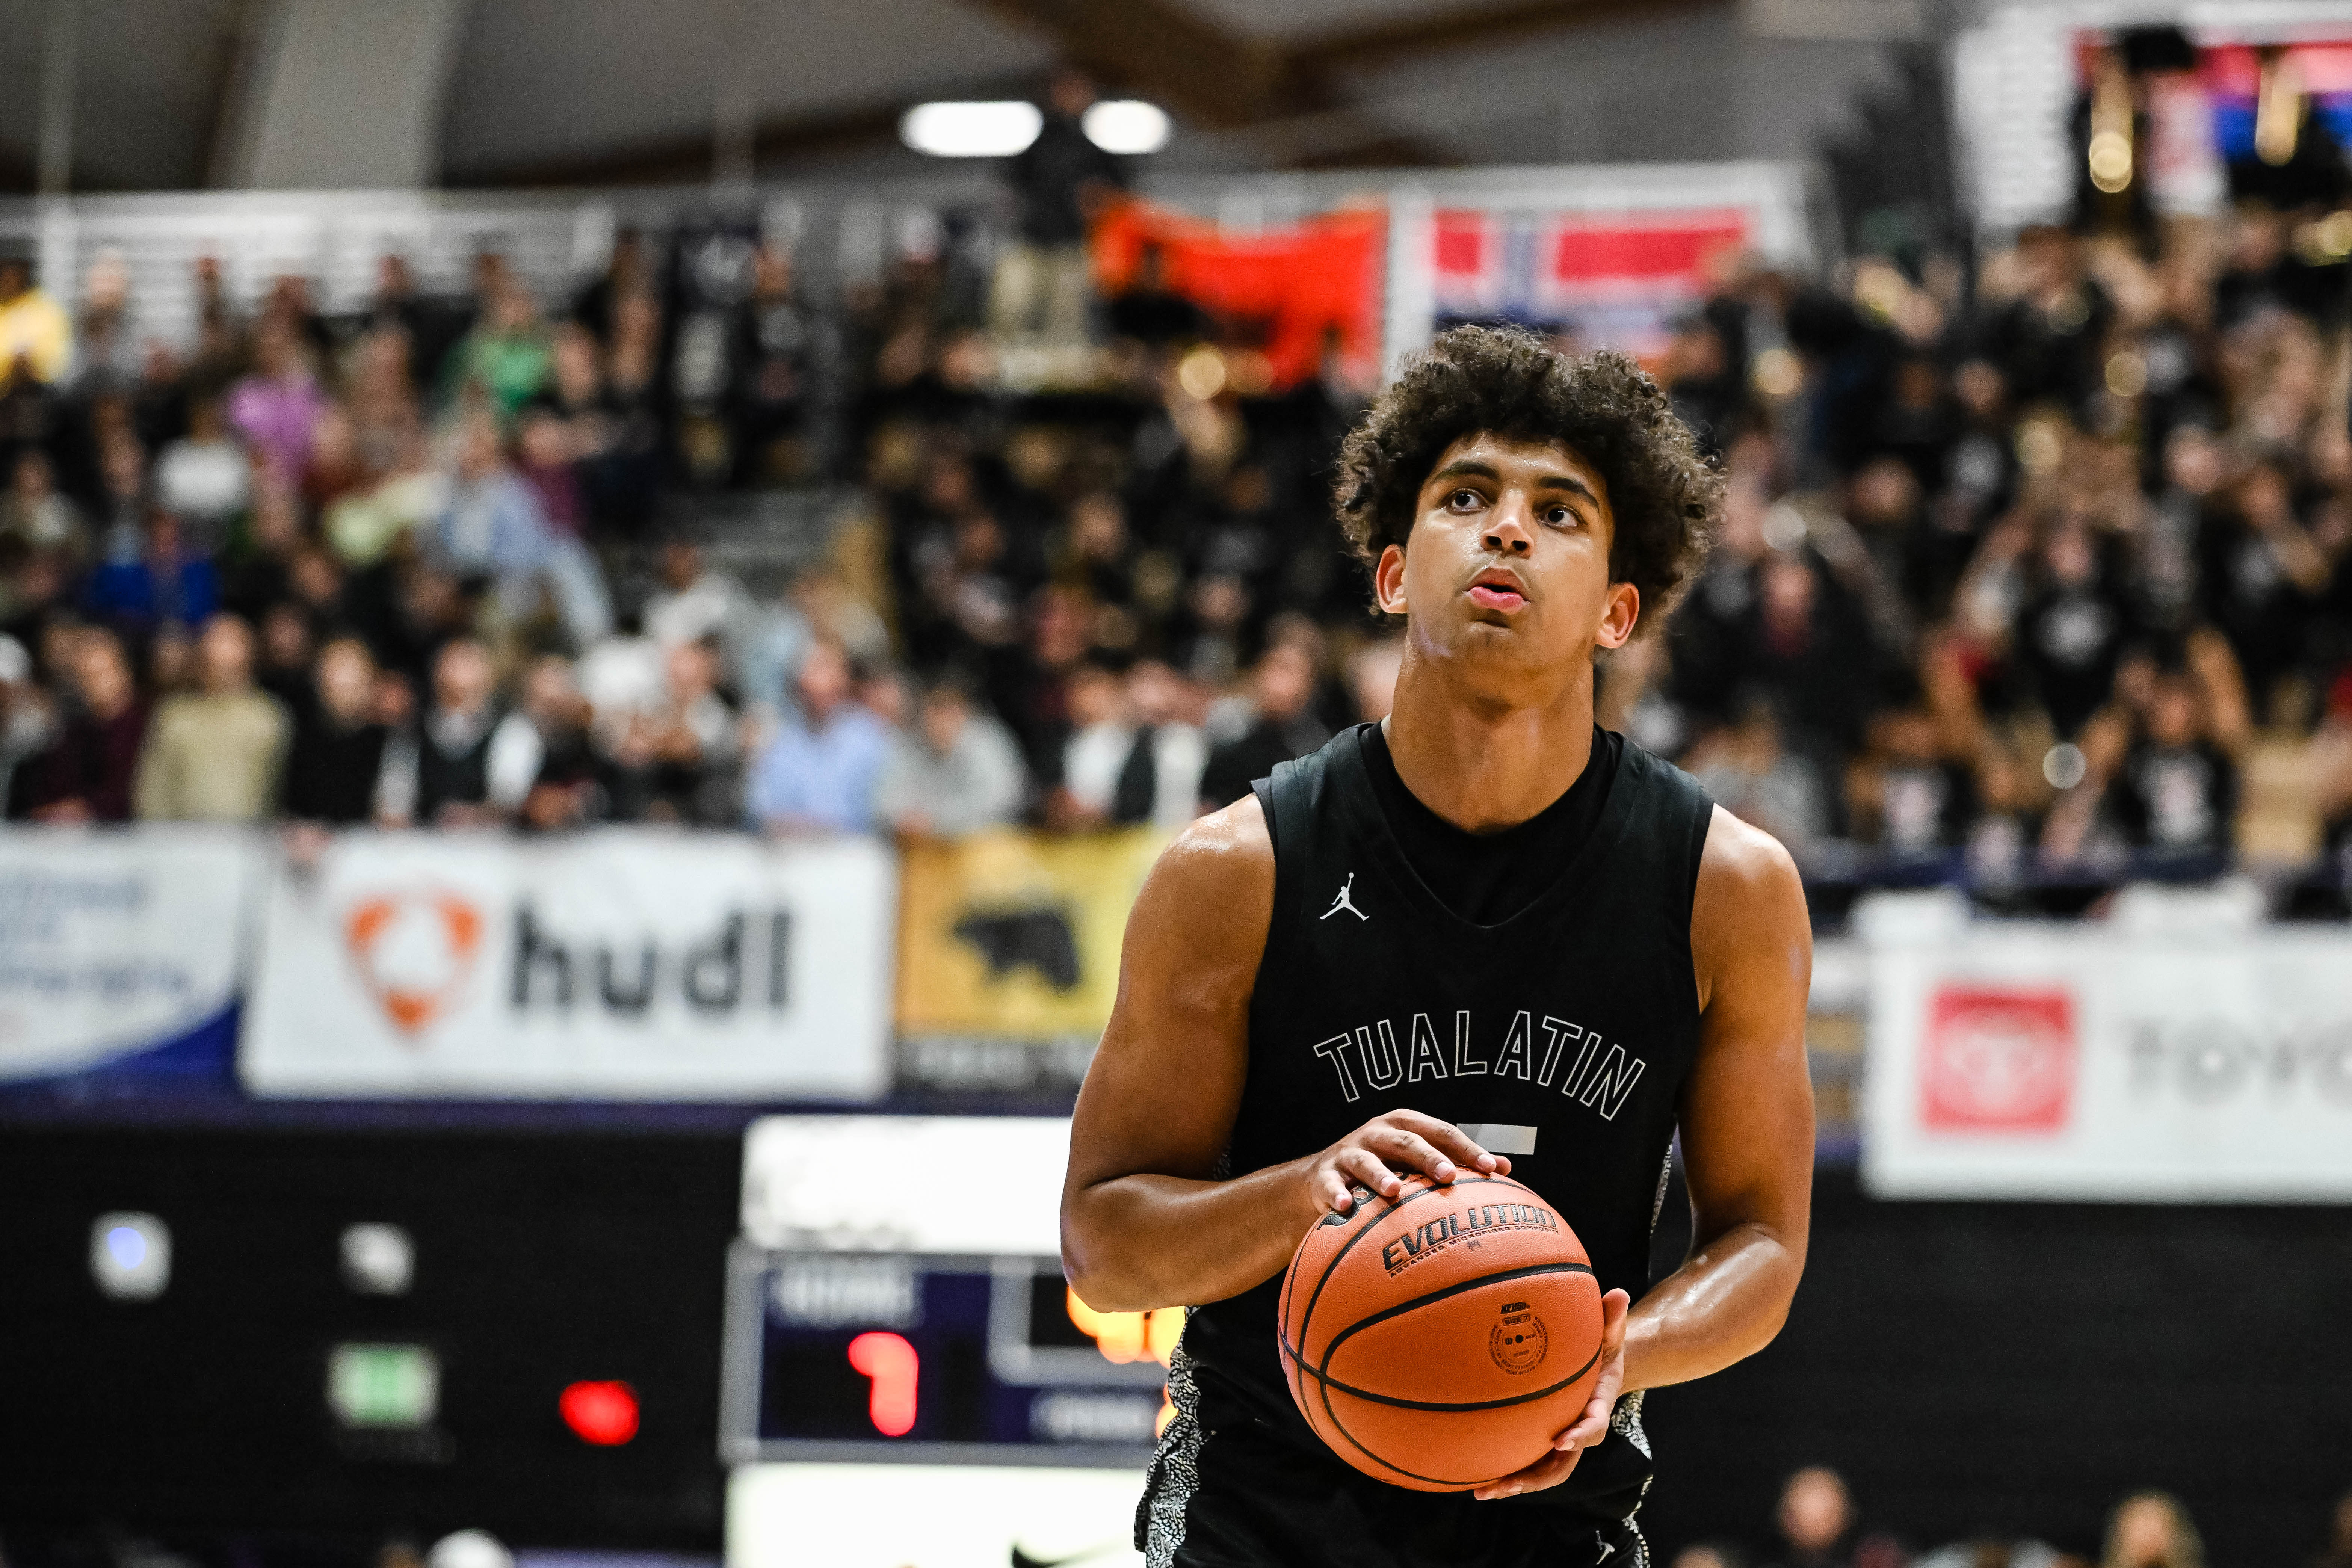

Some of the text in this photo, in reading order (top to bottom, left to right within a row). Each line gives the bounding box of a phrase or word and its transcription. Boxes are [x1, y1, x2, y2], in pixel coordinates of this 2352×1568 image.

[513, 905, 793, 1016] hudl
[1313, 1010, 1645, 1121] TUALATIN
[1382, 1204, 1556, 1270] EVOLUTION
[1390, 1245, 1444, 1278] ADVANCED
